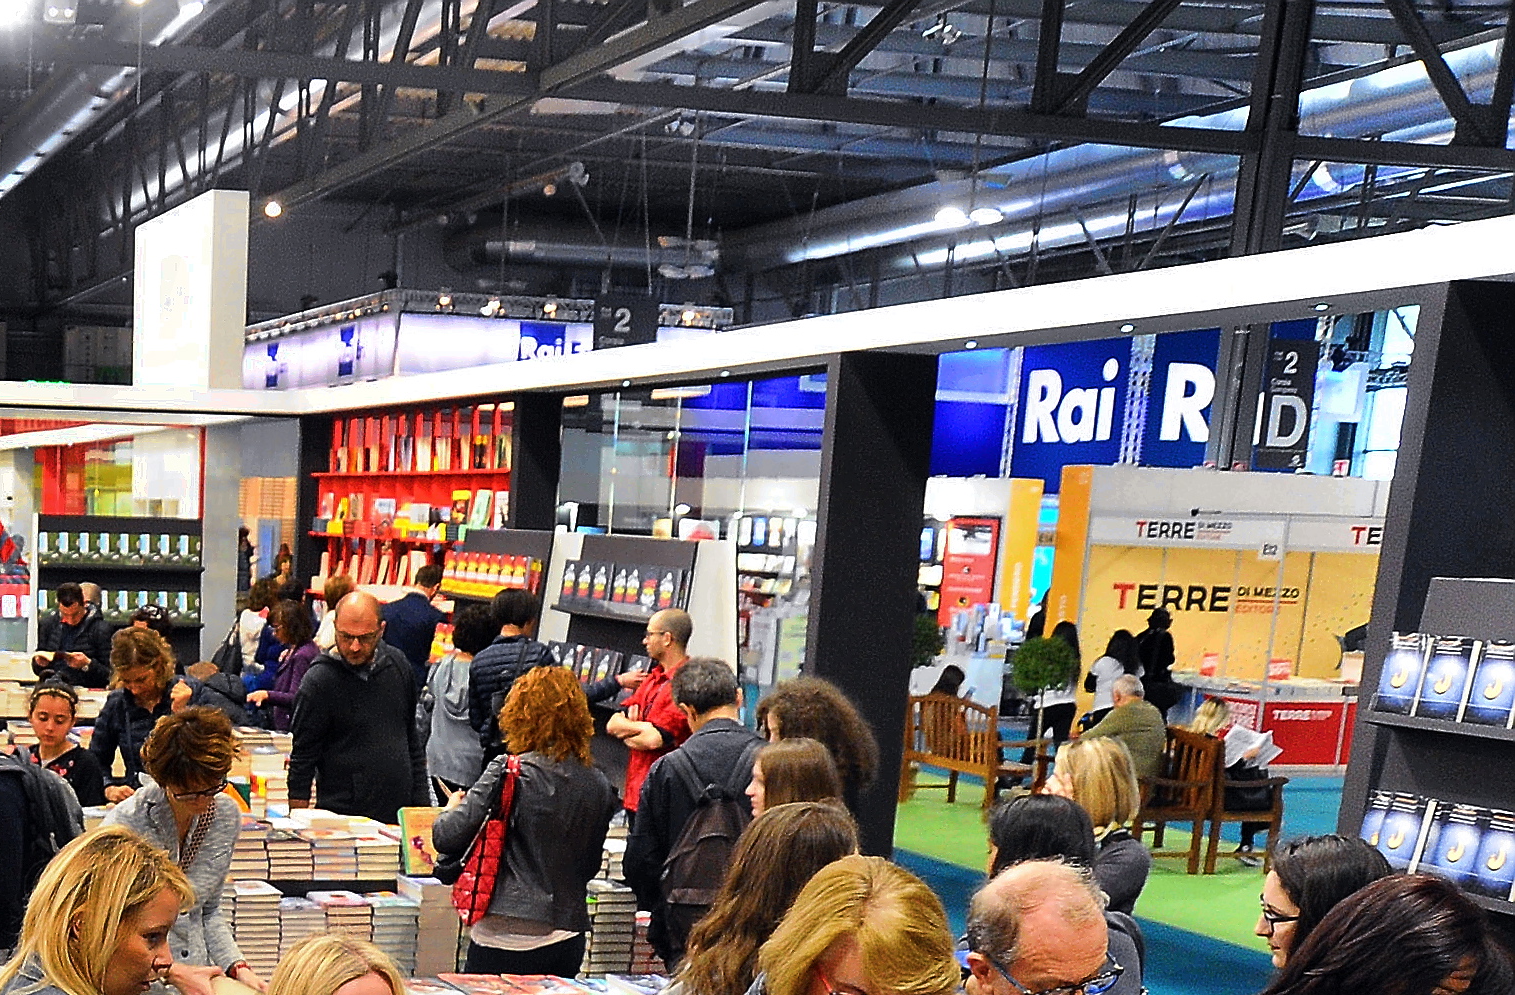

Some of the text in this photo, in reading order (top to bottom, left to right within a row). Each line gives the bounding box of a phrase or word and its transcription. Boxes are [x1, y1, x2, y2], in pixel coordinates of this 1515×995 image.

[614, 308, 632, 332] 2
[1283, 351, 1298, 374] 2
[1022, 358, 1119, 444] Rai
[1136, 521, 1196, 539] TERRE
[1113, 583, 1231, 613] TERRE
